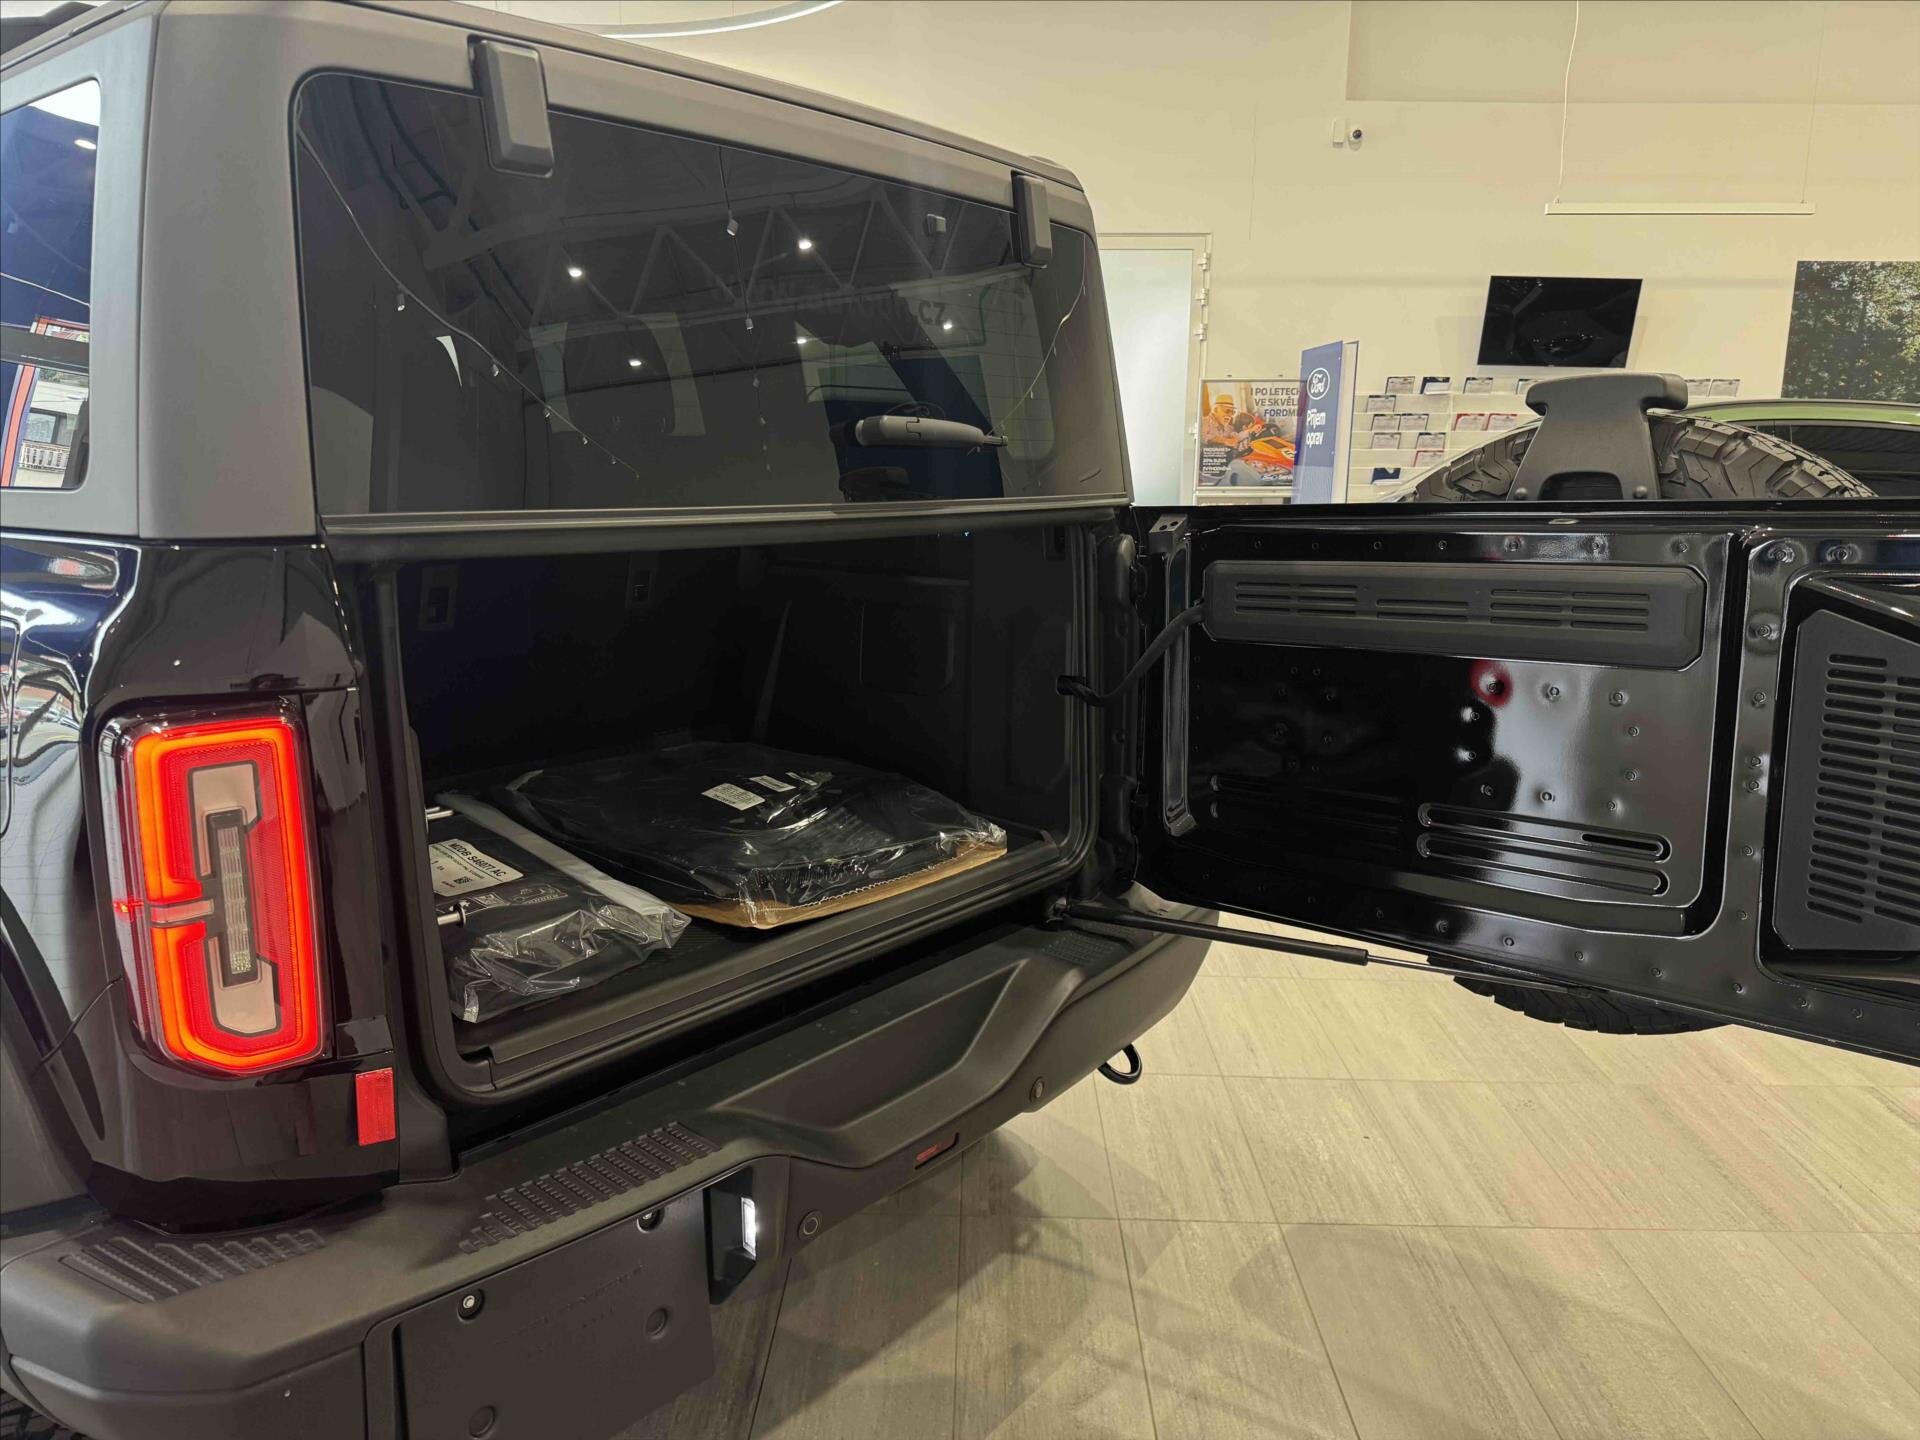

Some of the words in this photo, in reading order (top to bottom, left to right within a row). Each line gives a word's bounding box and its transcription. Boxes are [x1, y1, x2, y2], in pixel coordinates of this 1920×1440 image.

[1255, 388, 1268, 396] PO
[1254, 398, 1266, 406] VE
[1264, 408, 1298, 417] FORDM
[1306, 432, 1324, 448] oprav
[491, 869, 507, 877] AC
